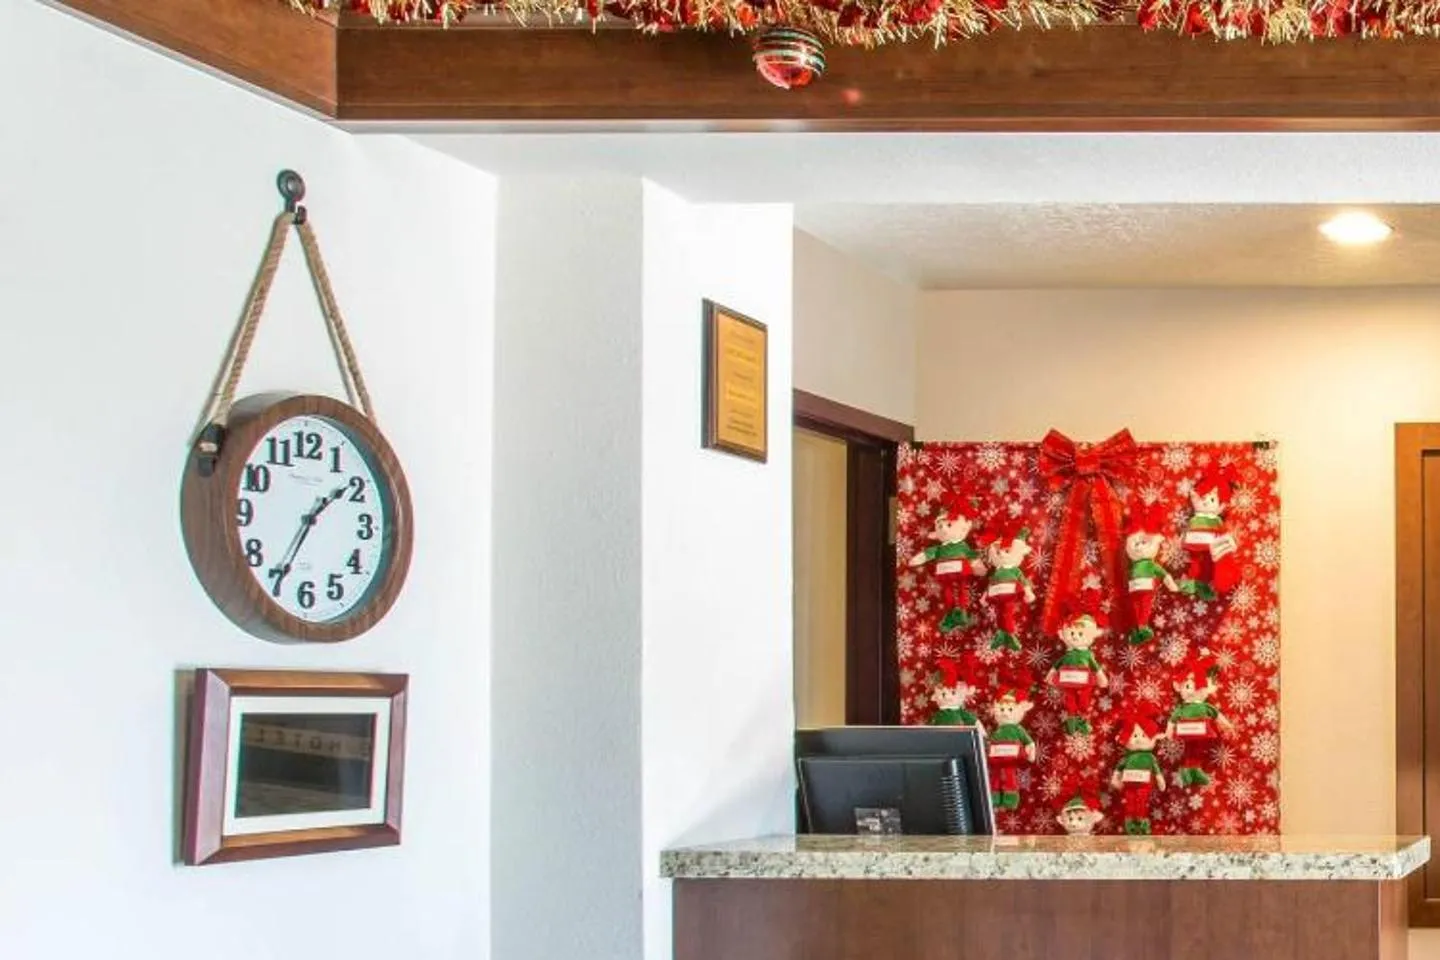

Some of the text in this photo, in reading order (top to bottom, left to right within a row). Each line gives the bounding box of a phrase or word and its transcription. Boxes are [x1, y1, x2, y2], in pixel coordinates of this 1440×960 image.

[266, 437, 294, 467] 11
[293, 431, 323, 460] 12
[330, 446, 343, 473] 1
[242, 463, 270, 493] 10
[348, 476, 365, 503] 2
[236, 498, 253, 527] 9
[357, 514, 373, 540] 3
[246, 539, 263, 568] 8
[346, 548, 362, 575] 4
[268, 567, 287, 596] 7
[297, 581, 316, 609] 6
[327, 573, 344, 601] 5
